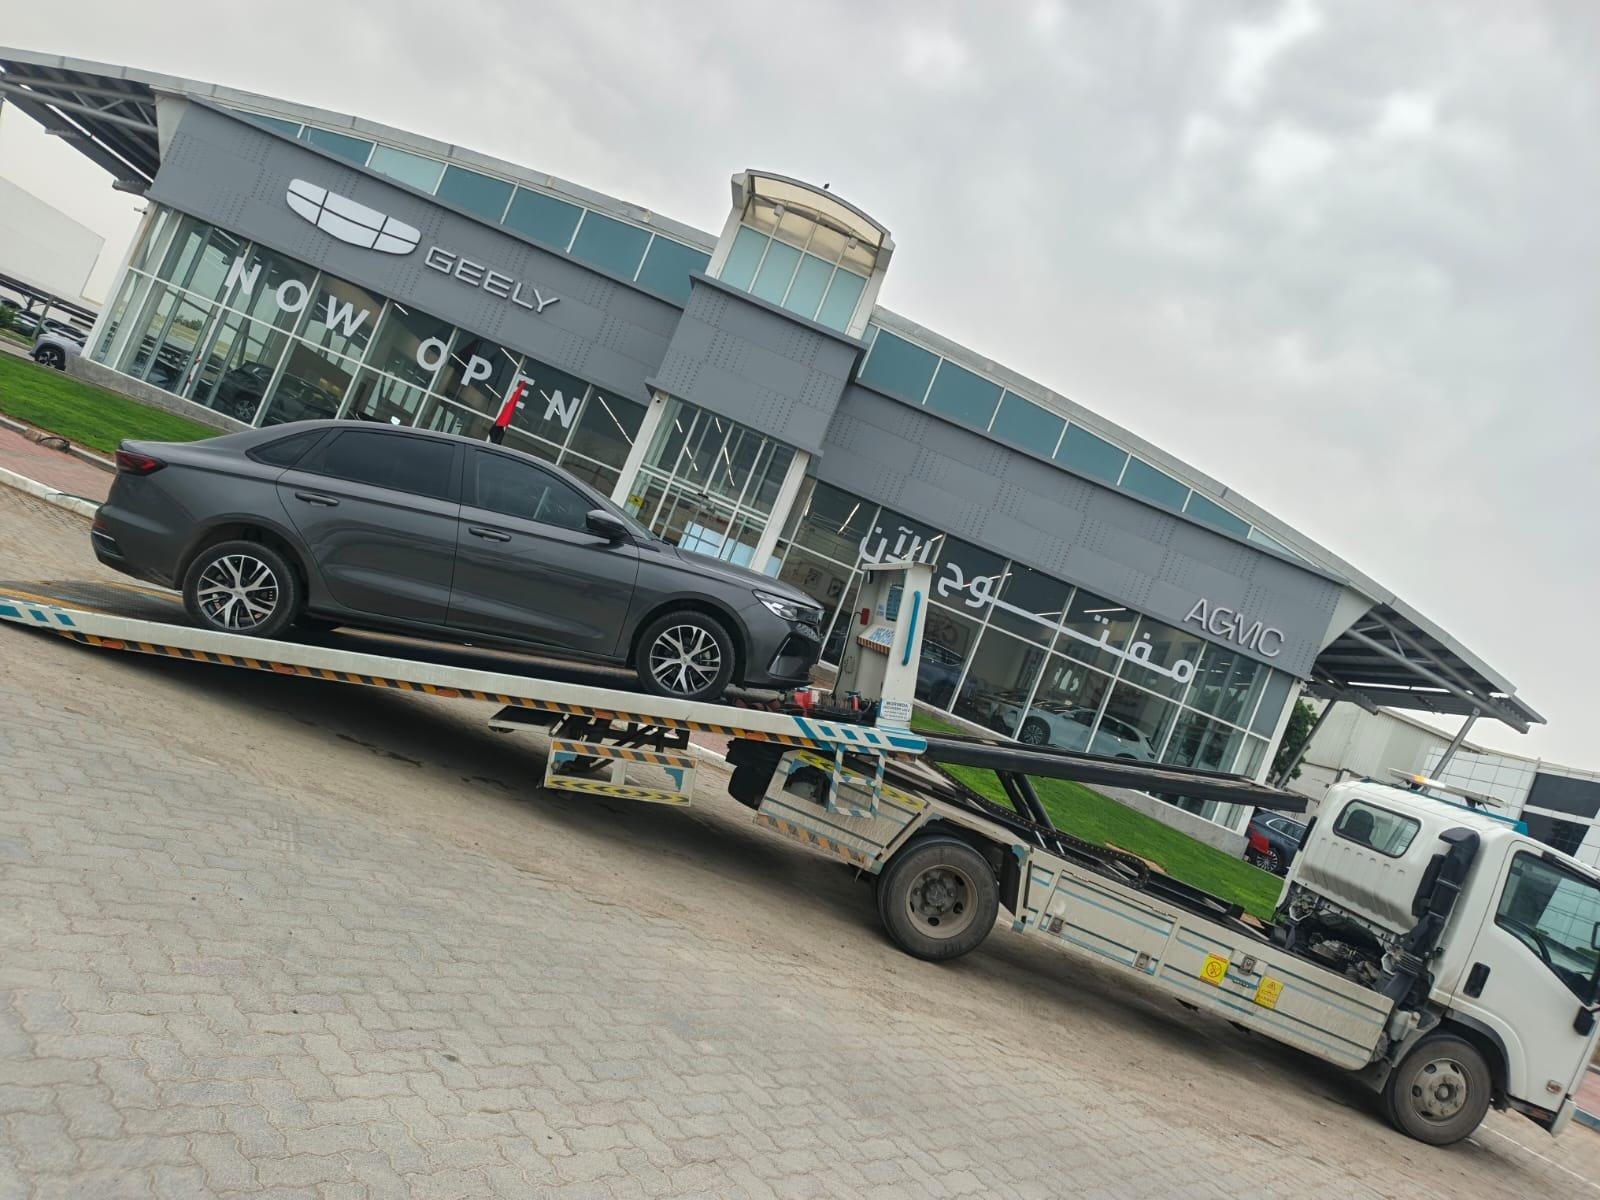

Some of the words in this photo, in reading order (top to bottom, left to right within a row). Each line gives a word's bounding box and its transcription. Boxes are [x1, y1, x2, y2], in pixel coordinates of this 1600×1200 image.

[424, 246, 560, 314] GEELY
[224, 256, 370, 338] NOW
[416, 338, 580, 430] OPEN
[937, 562, 1195, 684] مفتوح
[1183, 597, 1285, 657] AGMC
